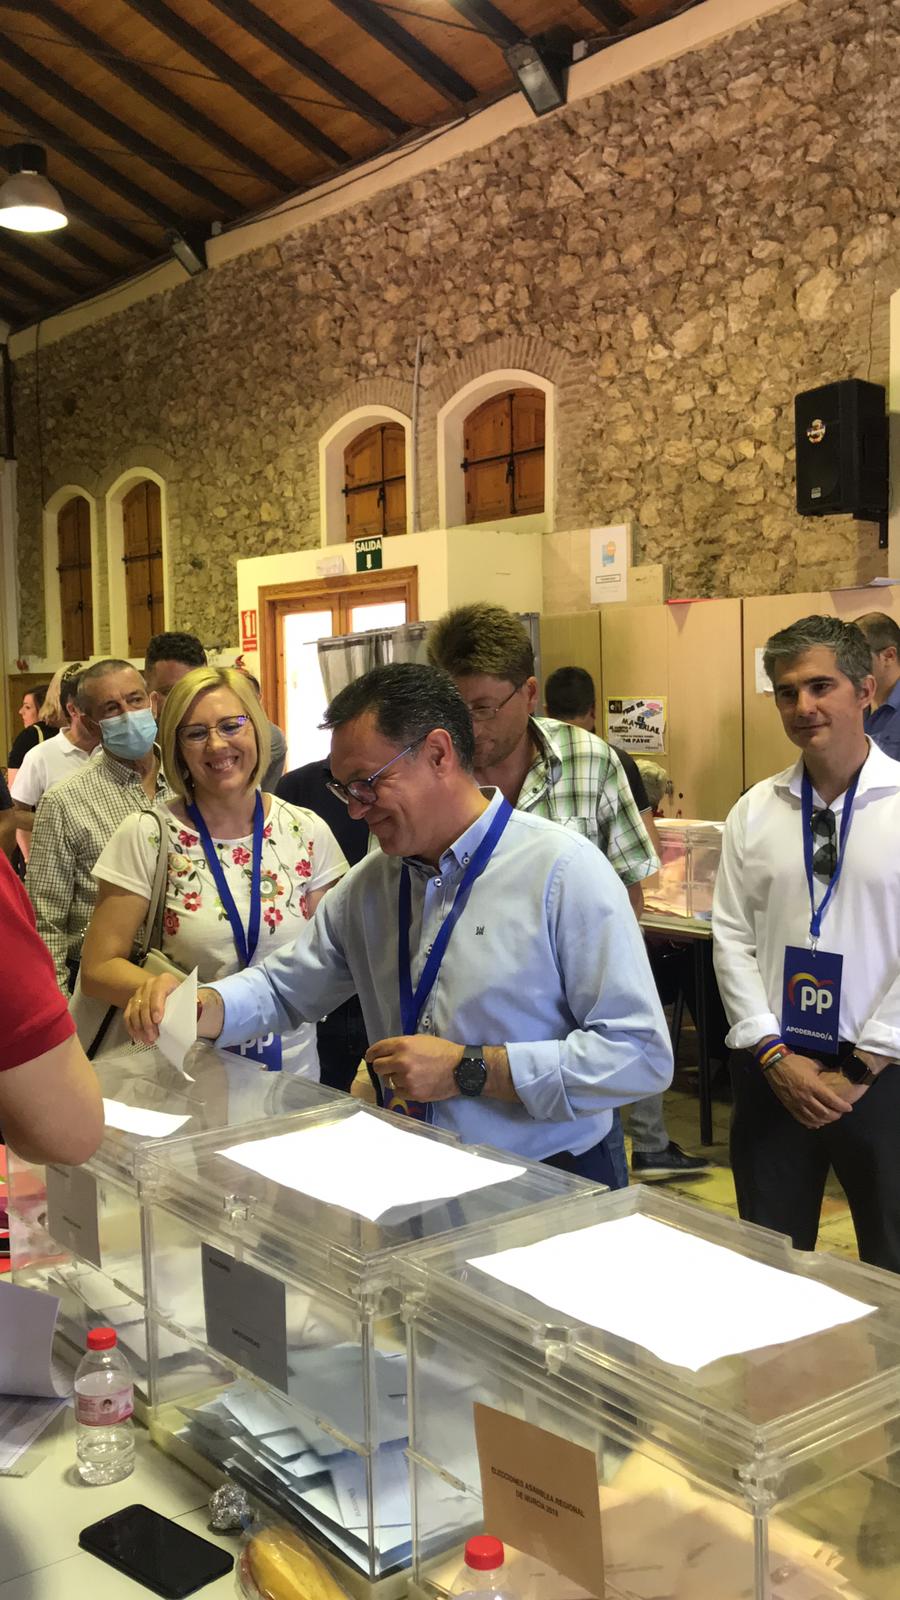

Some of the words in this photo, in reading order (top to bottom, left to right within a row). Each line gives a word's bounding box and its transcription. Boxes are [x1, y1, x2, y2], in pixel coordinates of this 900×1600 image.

[356, 540, 381, 552] SALIDA
[786, 1026, 833, 1041] APODERADO/A
[491, 1466, 524, 1487] ELECCIONES
[525, 1482, 554, 1502] ASAMBLEA
[555, 1498, 585, 1518] REGIONAL
[515, 1489, 523, 1500] DE
[524, 1494, 545, 1510] MURCIA
